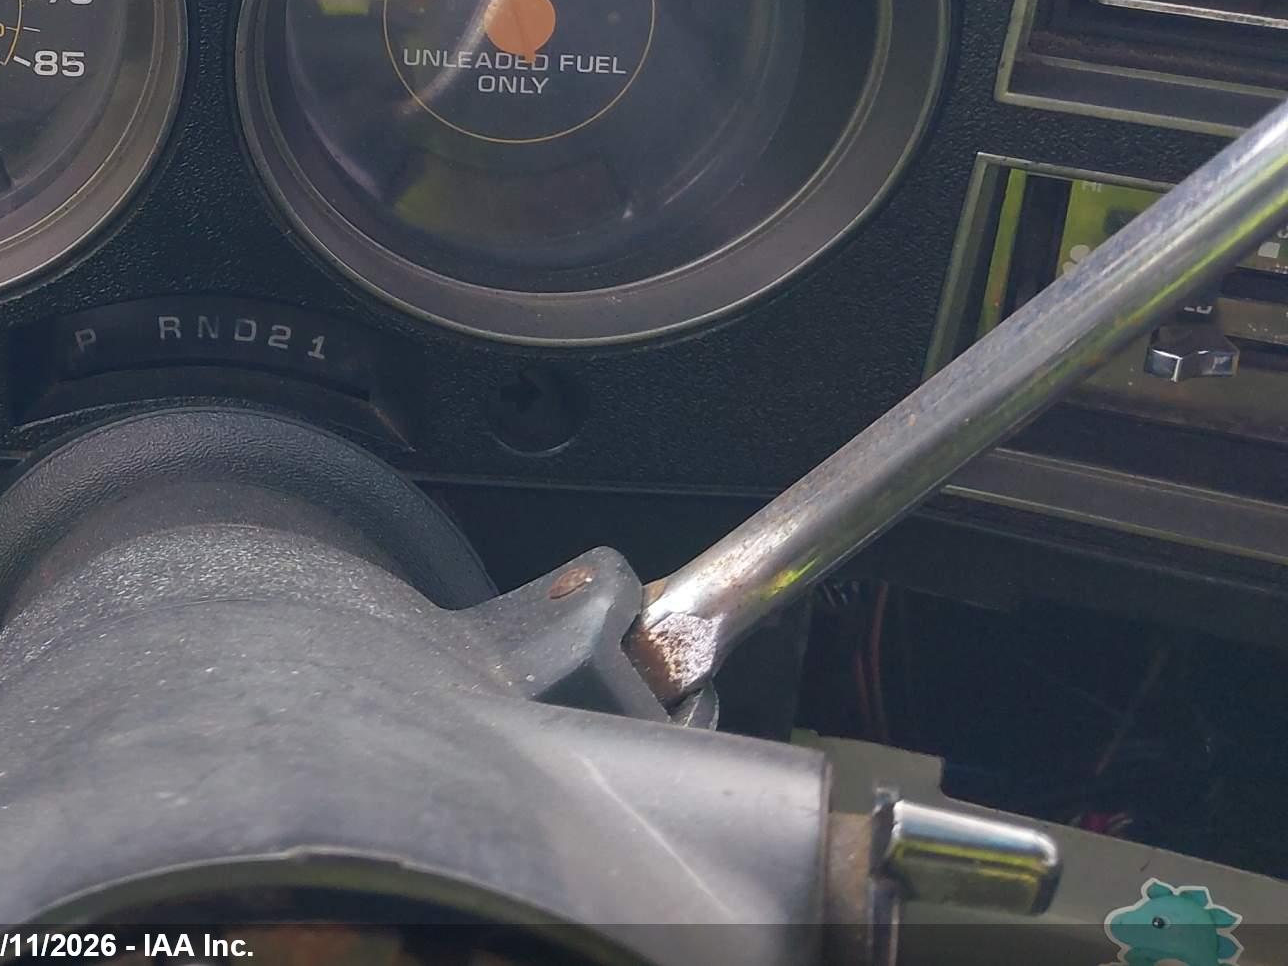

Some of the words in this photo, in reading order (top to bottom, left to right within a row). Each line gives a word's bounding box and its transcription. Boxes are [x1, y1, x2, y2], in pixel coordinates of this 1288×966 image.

[33, 50, 86, 78] 85
[403, 48, 549, 72] UNLEADED
[559, 53, 627, 74] FUEL
[477, 75, 549, 94] ONLY
